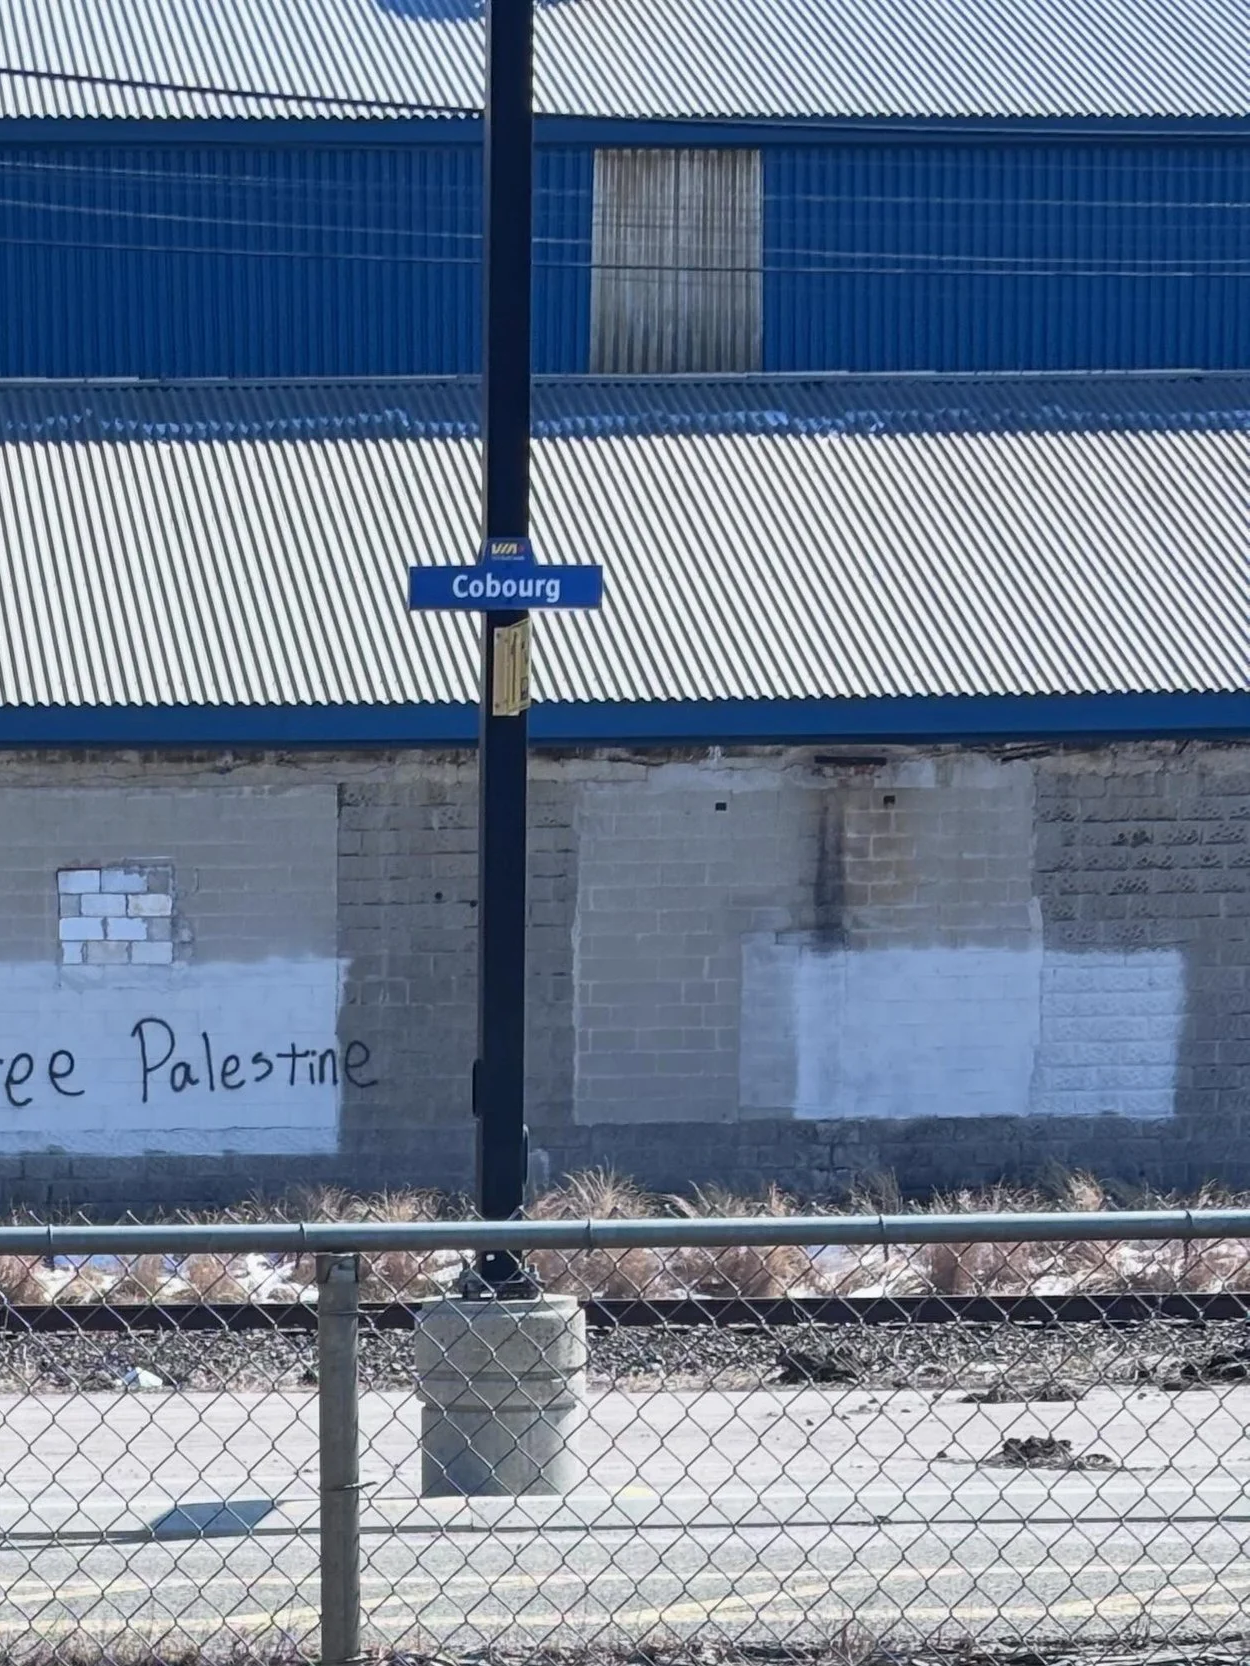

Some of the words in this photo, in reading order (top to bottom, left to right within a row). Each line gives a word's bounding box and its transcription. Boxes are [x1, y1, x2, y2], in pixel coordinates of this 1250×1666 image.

[491, 543, 518, 555] VIA
[452, 573, 561, 603] Cobourg
[131, 1017, 379, 1103] Palestine
